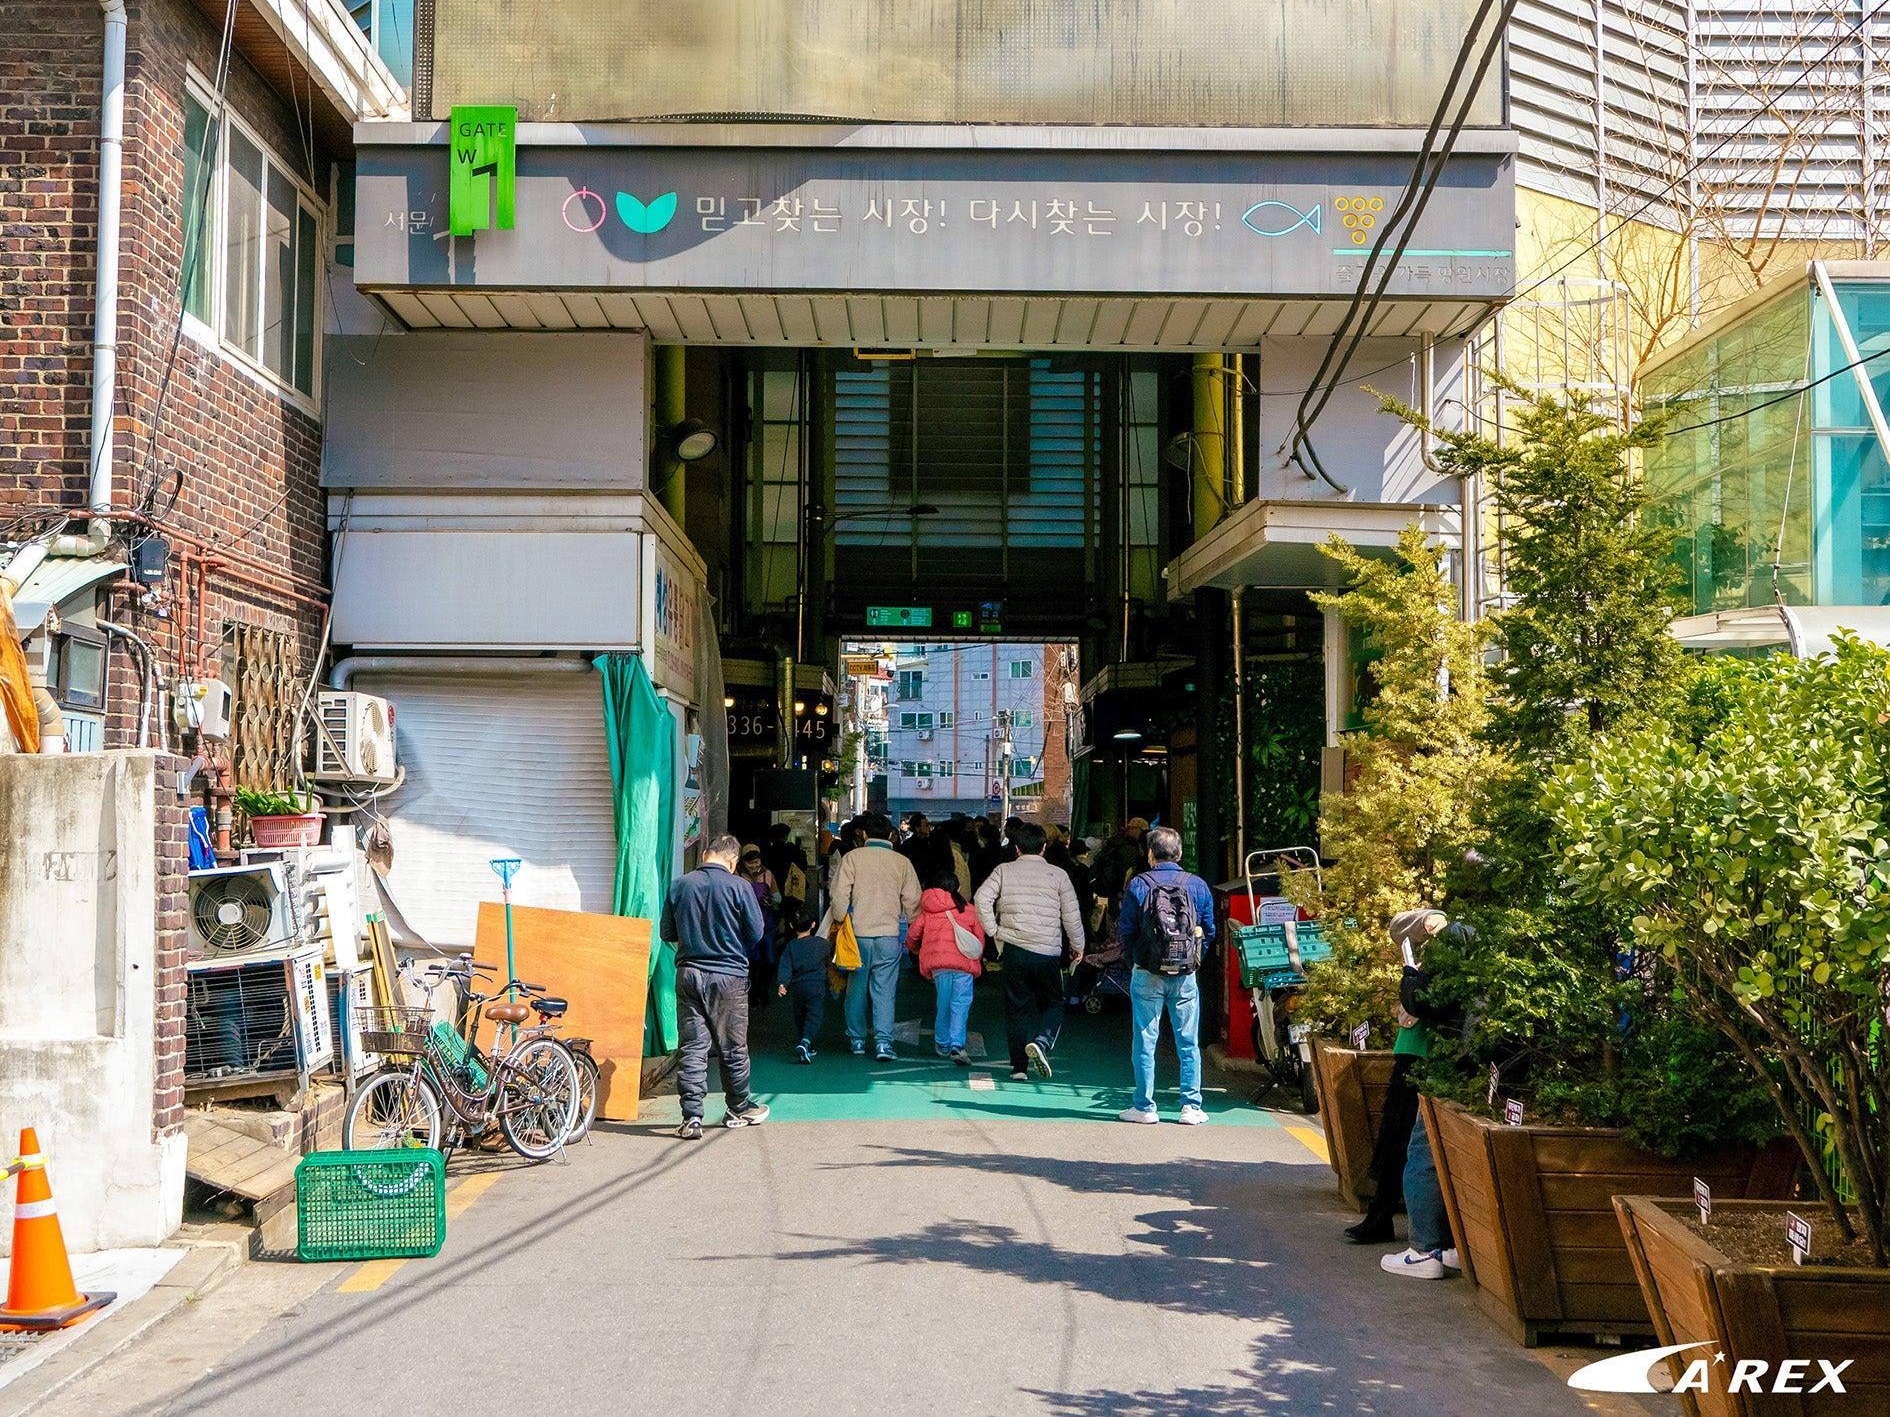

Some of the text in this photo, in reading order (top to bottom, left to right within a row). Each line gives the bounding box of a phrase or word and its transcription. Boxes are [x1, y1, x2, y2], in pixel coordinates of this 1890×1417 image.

[459, 123, 507, 141] GATE
[384, 210, 430, 235] 서문
[862, 197, 948, 235] 시장!
[969, 197, 1118, 235] 다시찾는
[1136, 200, 1223, 237] 시장!
[1438, 266, 1511, 286] 망원시장
[728, 715, 825, 739] 336-45
